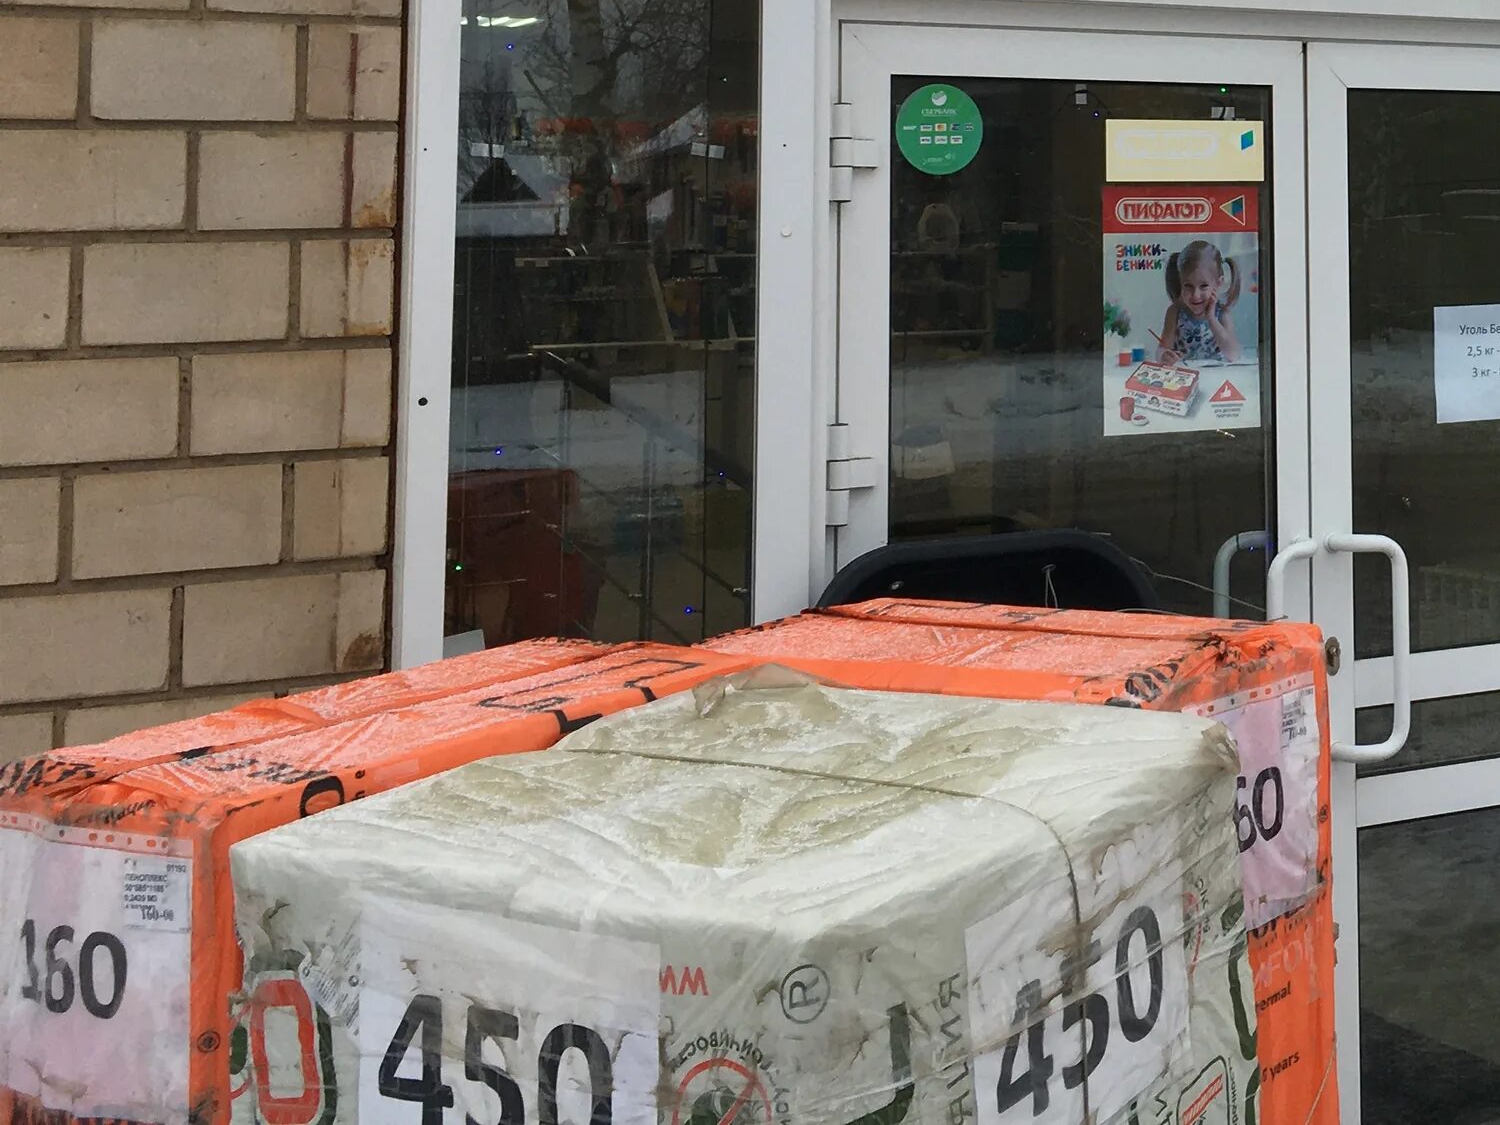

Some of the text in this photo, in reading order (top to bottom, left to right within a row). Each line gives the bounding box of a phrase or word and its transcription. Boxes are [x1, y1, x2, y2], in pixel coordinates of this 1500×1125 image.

[1122, 200, 1206, 221] ПИФАГОР
[1115, 243, 1168, 258] ЭНИКИ-
[1115, 258, 1162, 272] БЕНИКИ
[1459, 324, 1488, 336] Уголь
[1466, 345, 1482, 358] 2,5
[1484, 347, 1494, 356] кг
[1472, 367, 1478, 378] 3
[1480, 369, 1491, 377] кг
[1233, 766, 1284, 853] 60
[20, 918, 128, 1020] 160
[1255, 980, 1292, 1012] ermal
[996, 905, 1164, 1118] 450
[378, 993, 613, 1125] 450
[1269, 1051, 1301, 1082] years
